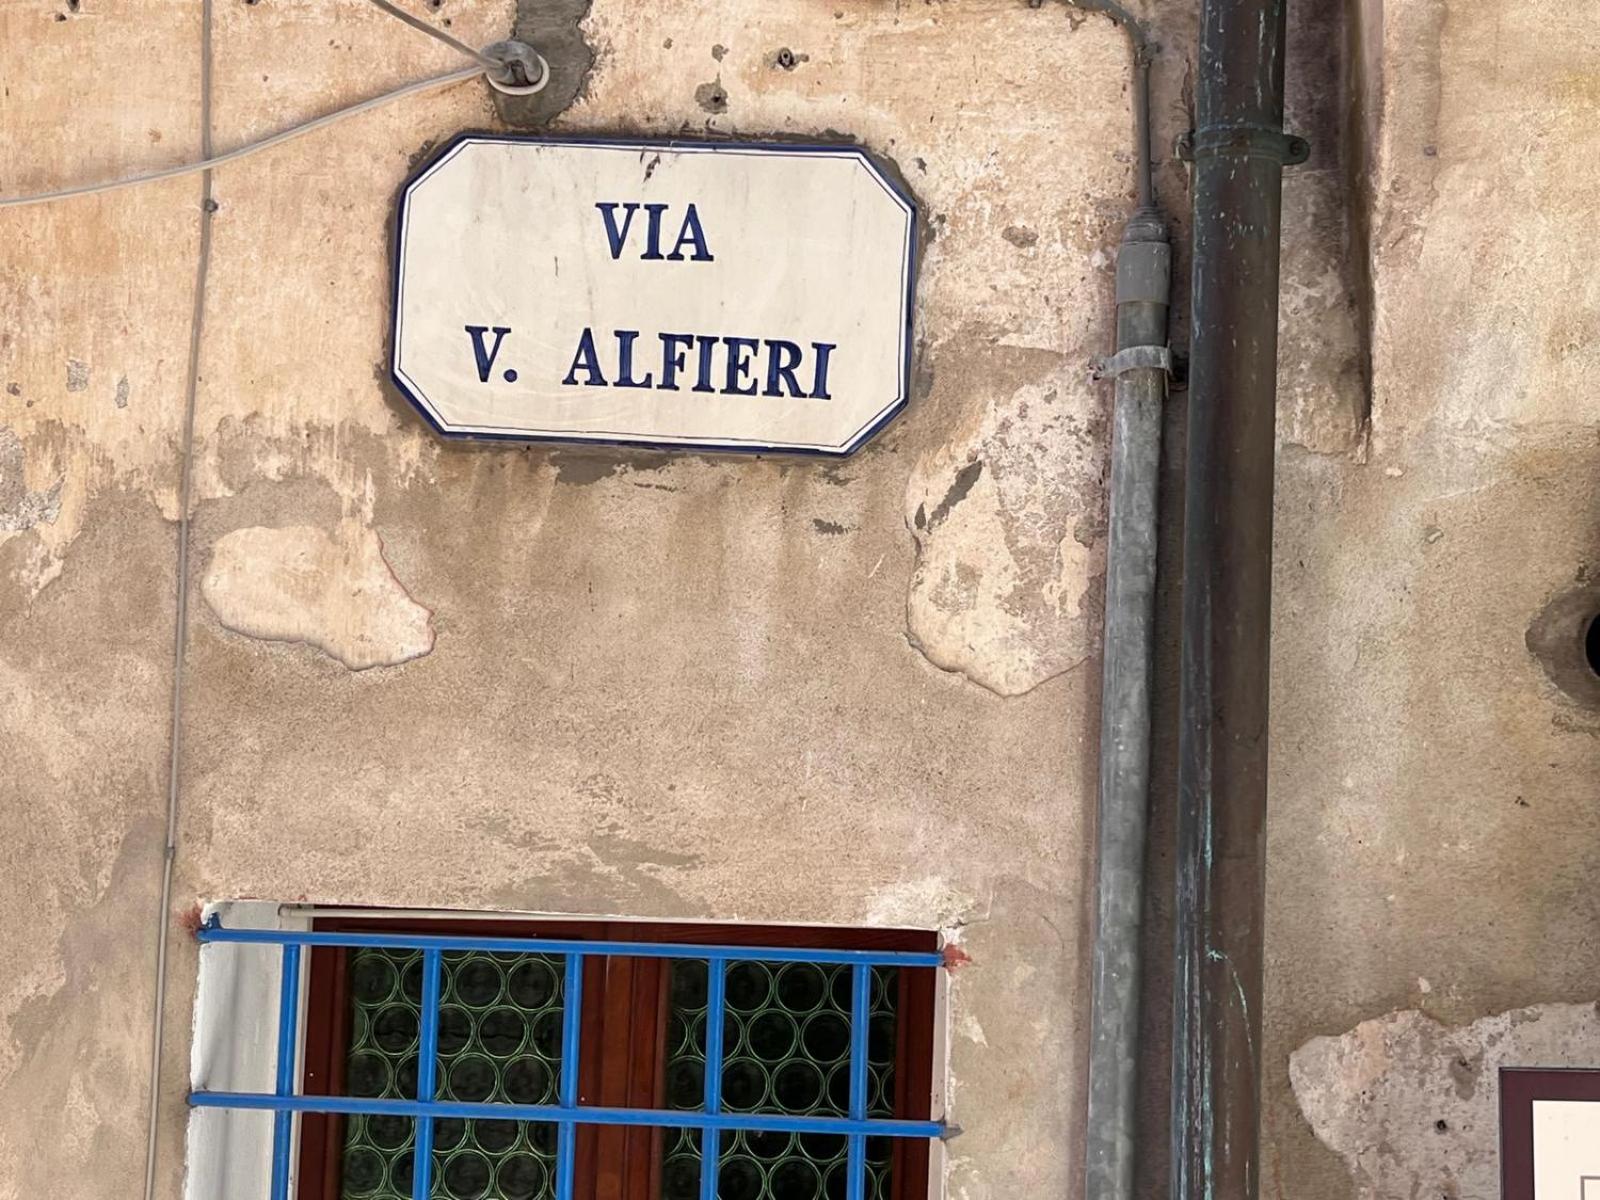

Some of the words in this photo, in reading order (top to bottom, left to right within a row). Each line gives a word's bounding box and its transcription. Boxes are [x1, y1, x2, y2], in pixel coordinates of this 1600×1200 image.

[595, 202, 715, 262] VIA
[464, 325, 518, 383] V.
[561, 327, 837, 401] ALFIERI
